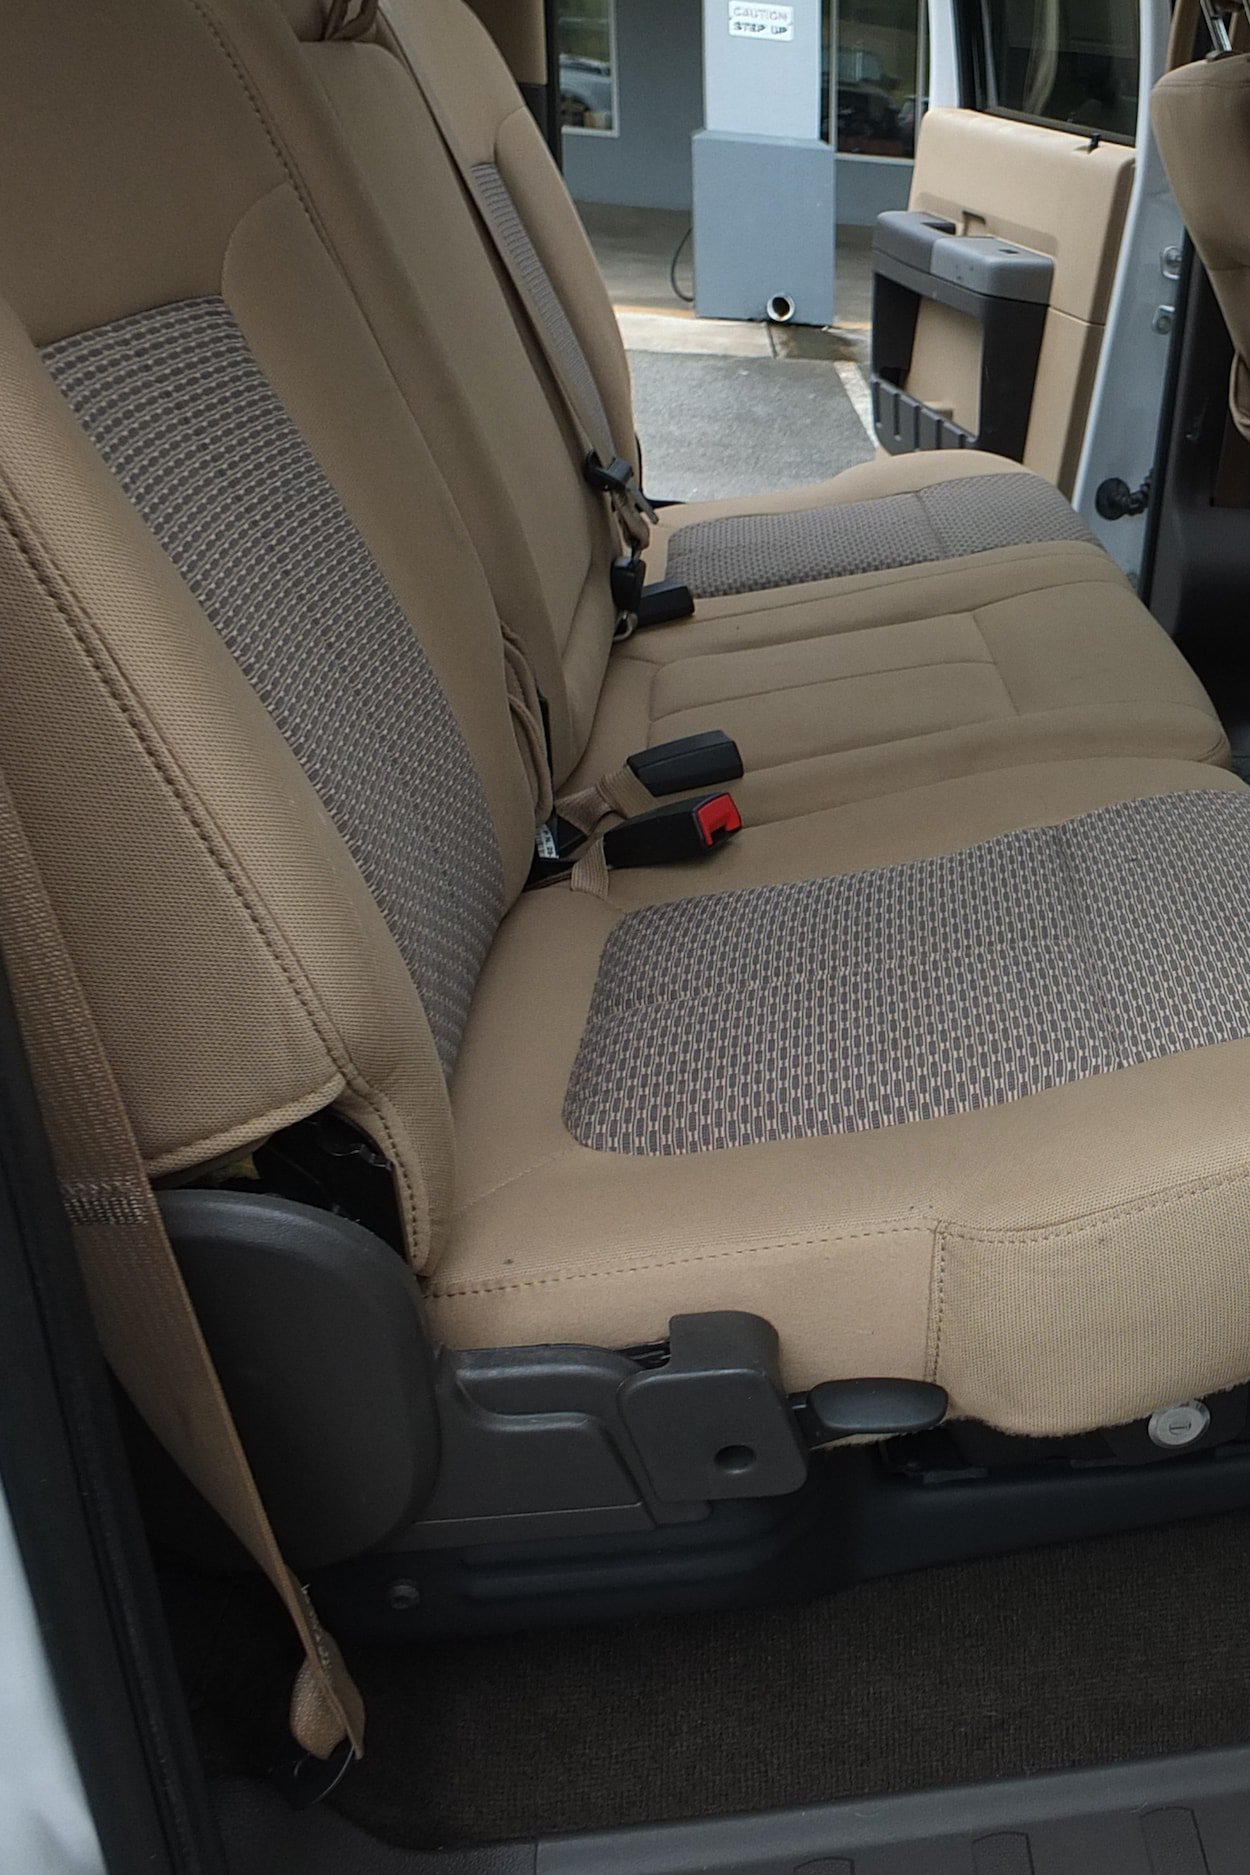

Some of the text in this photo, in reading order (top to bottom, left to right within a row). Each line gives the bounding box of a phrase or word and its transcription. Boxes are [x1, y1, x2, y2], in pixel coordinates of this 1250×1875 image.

[733, 7, 788, 21] CAUTION
[733, 21, 788, 35] STEP UP
